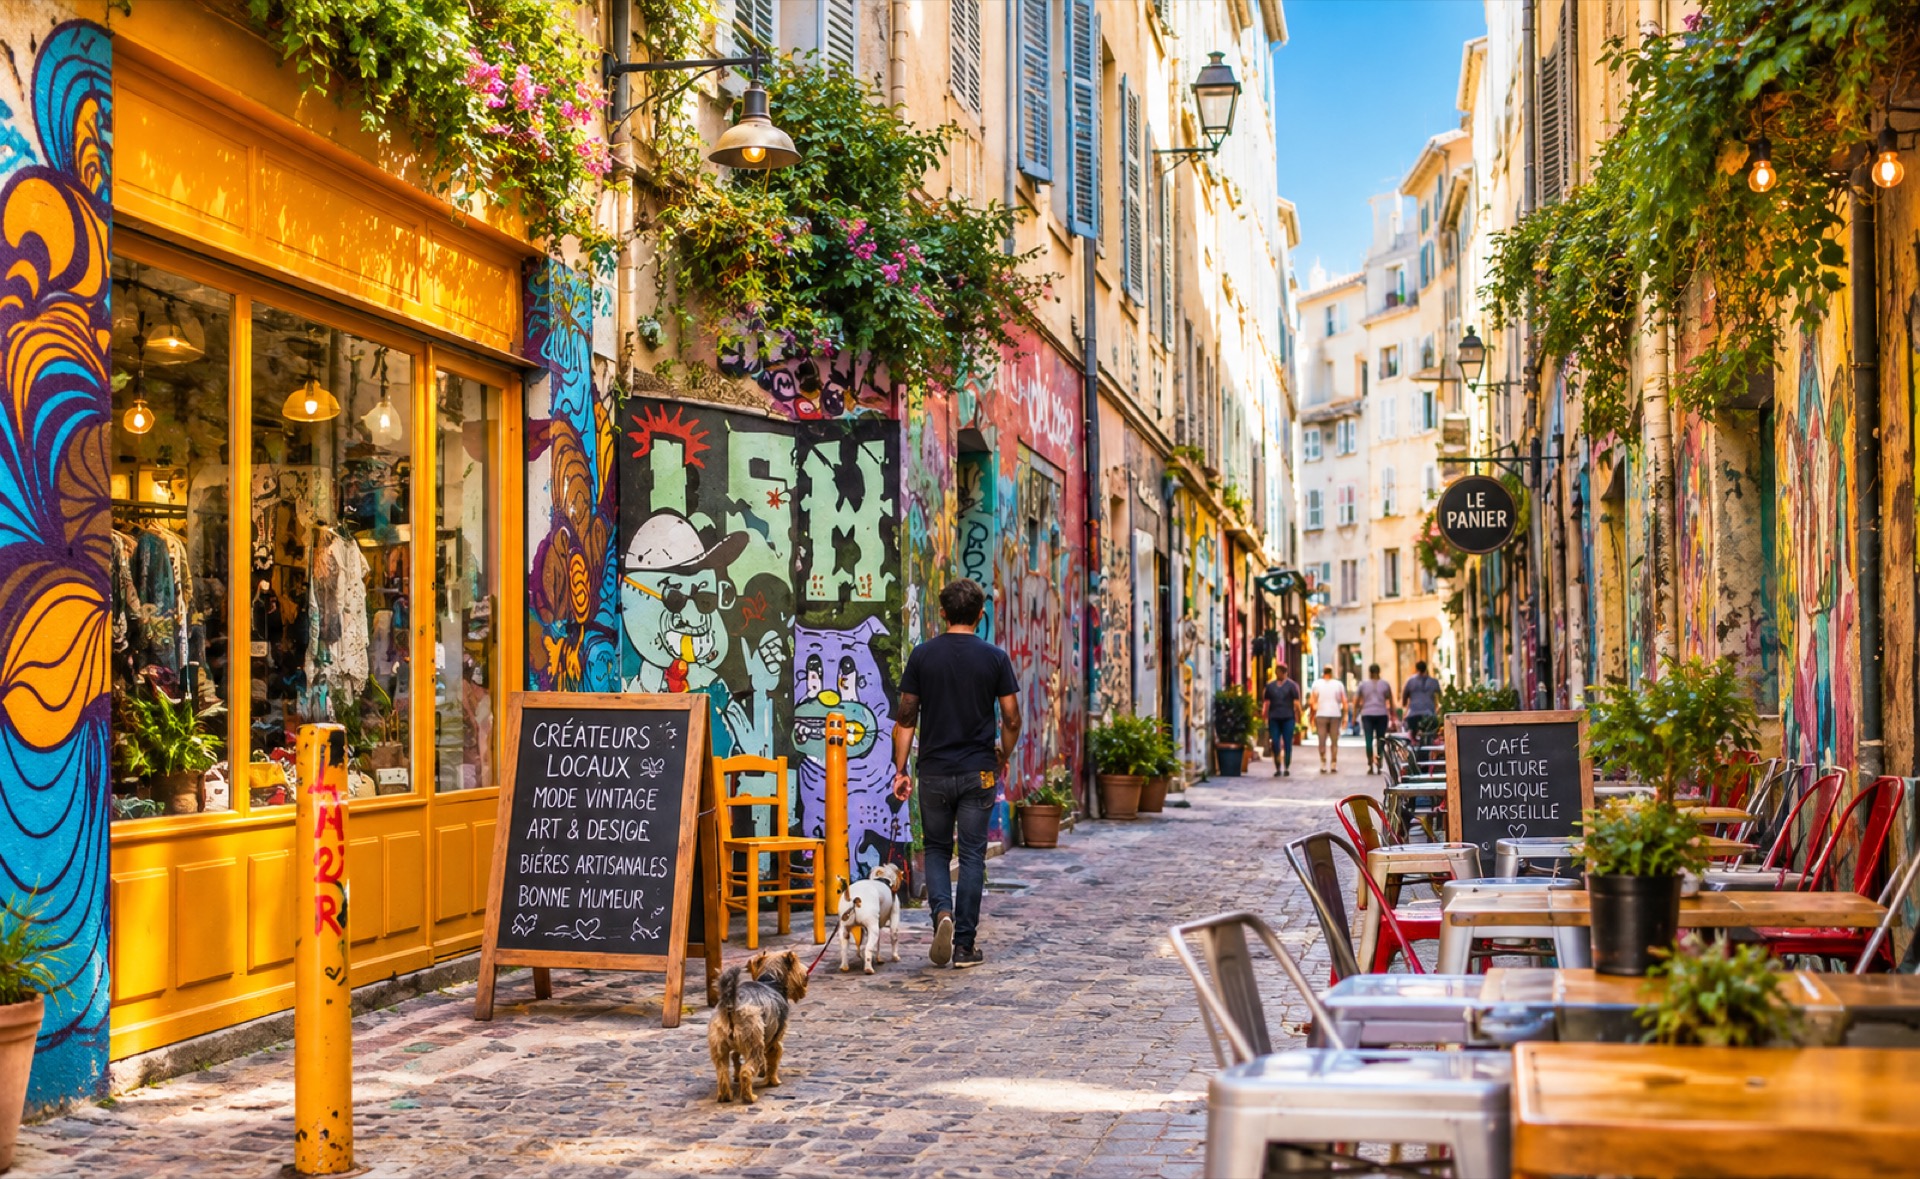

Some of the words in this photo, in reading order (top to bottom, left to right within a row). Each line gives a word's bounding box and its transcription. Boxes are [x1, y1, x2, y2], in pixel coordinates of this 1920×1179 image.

[1466, 492, 1486, 508] LE
[1447, 510, 1507, 529] PANIER
[533, 717, 651, 749] CRÉATEURS
[1486, 733, 1530, 756] CAFÉ
[546, 754, 631, 779] LOCAUX
[1477, 760, 1548, 777] CULTURE
[532, 786, 578, 809] MODE
[585, 787, 659, 811] VINTAGE
[1480, 782, 1549, 802] MUSIQUE
[1477, 803, 1559, 820] MARSEILLE
[526, 818, 563, 840] ART
[567, 818, 580, 840] &
[574, 855, 668, 878] ARTISANALES
[518, 884, 571, 908] BONNE
